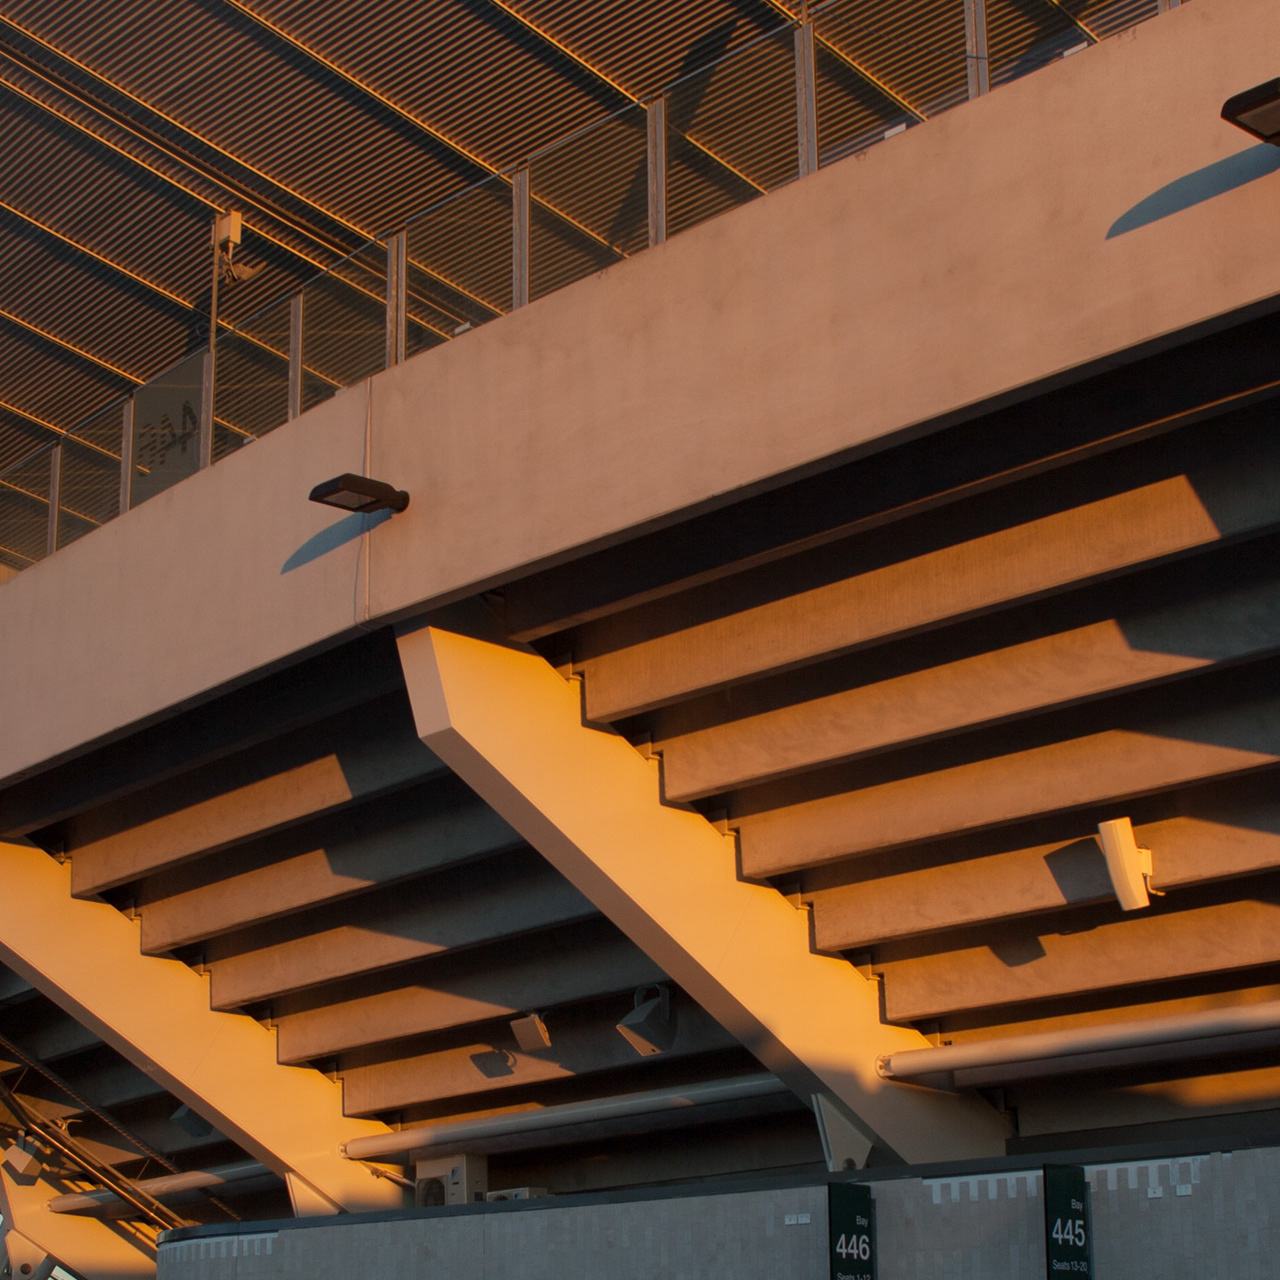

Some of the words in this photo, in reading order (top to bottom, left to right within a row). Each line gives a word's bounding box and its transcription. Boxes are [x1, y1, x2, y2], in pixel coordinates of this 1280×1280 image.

[1071, 1199, 1083, 1211] Bay
[856, 1215, 868, 1227] Bay
[1052, 1218, 1085, 1246] 445
[836, 1233, 870, 1260] 446
[1052, 1259, 1070, 1270] Seats
